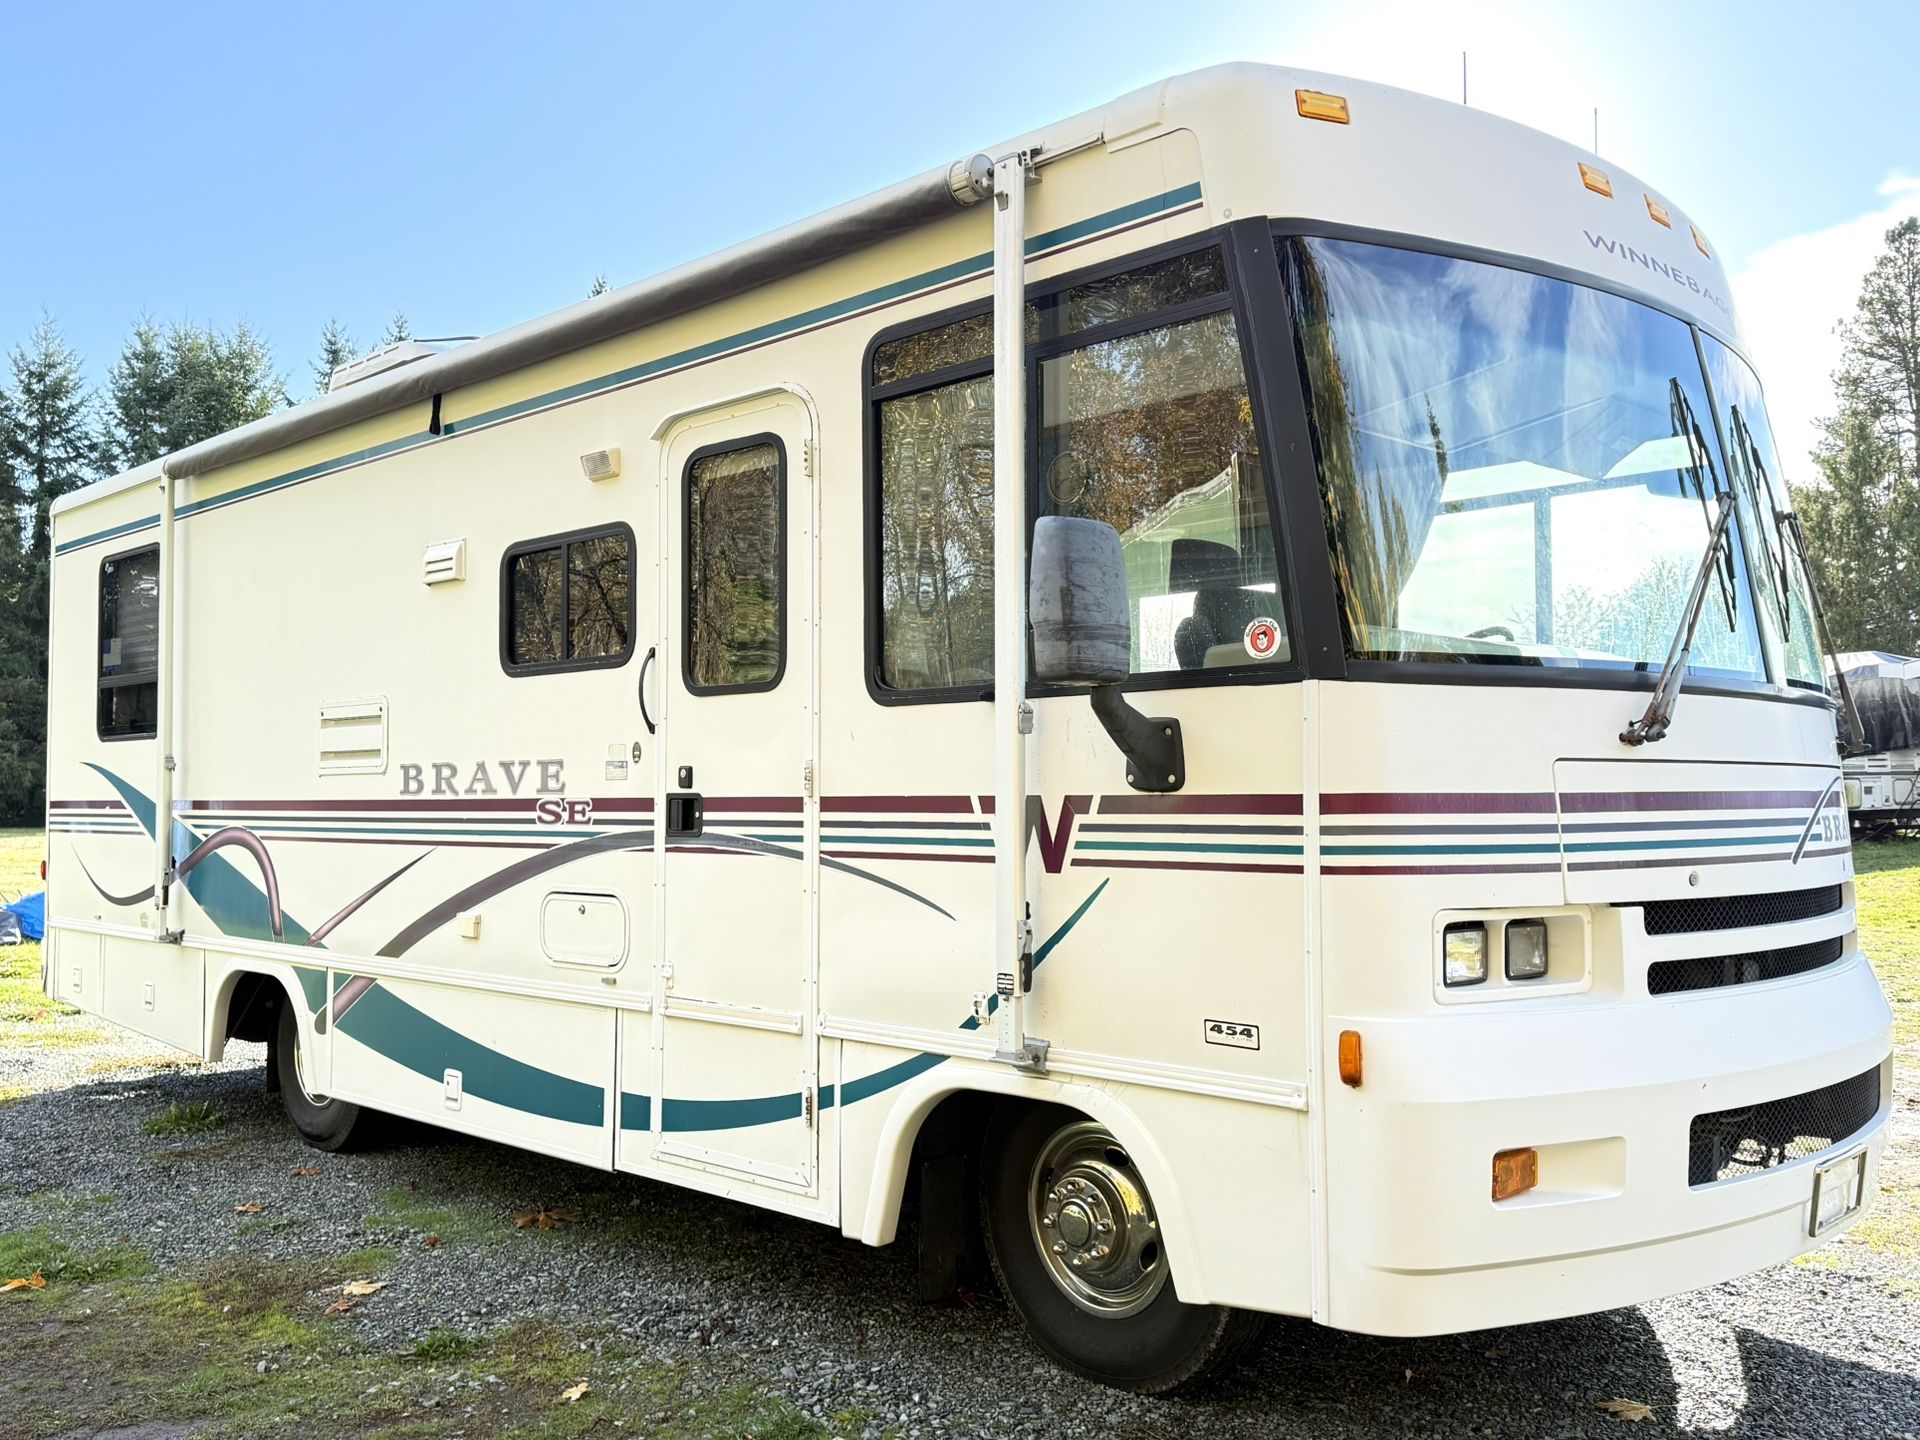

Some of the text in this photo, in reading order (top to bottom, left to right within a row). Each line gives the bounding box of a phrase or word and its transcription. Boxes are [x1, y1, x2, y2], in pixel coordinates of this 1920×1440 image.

[399, 758, 566, 796] BRAVE
[535, 798, 593, 825] SE
[1209, 1023, 1254, 1039] 454
